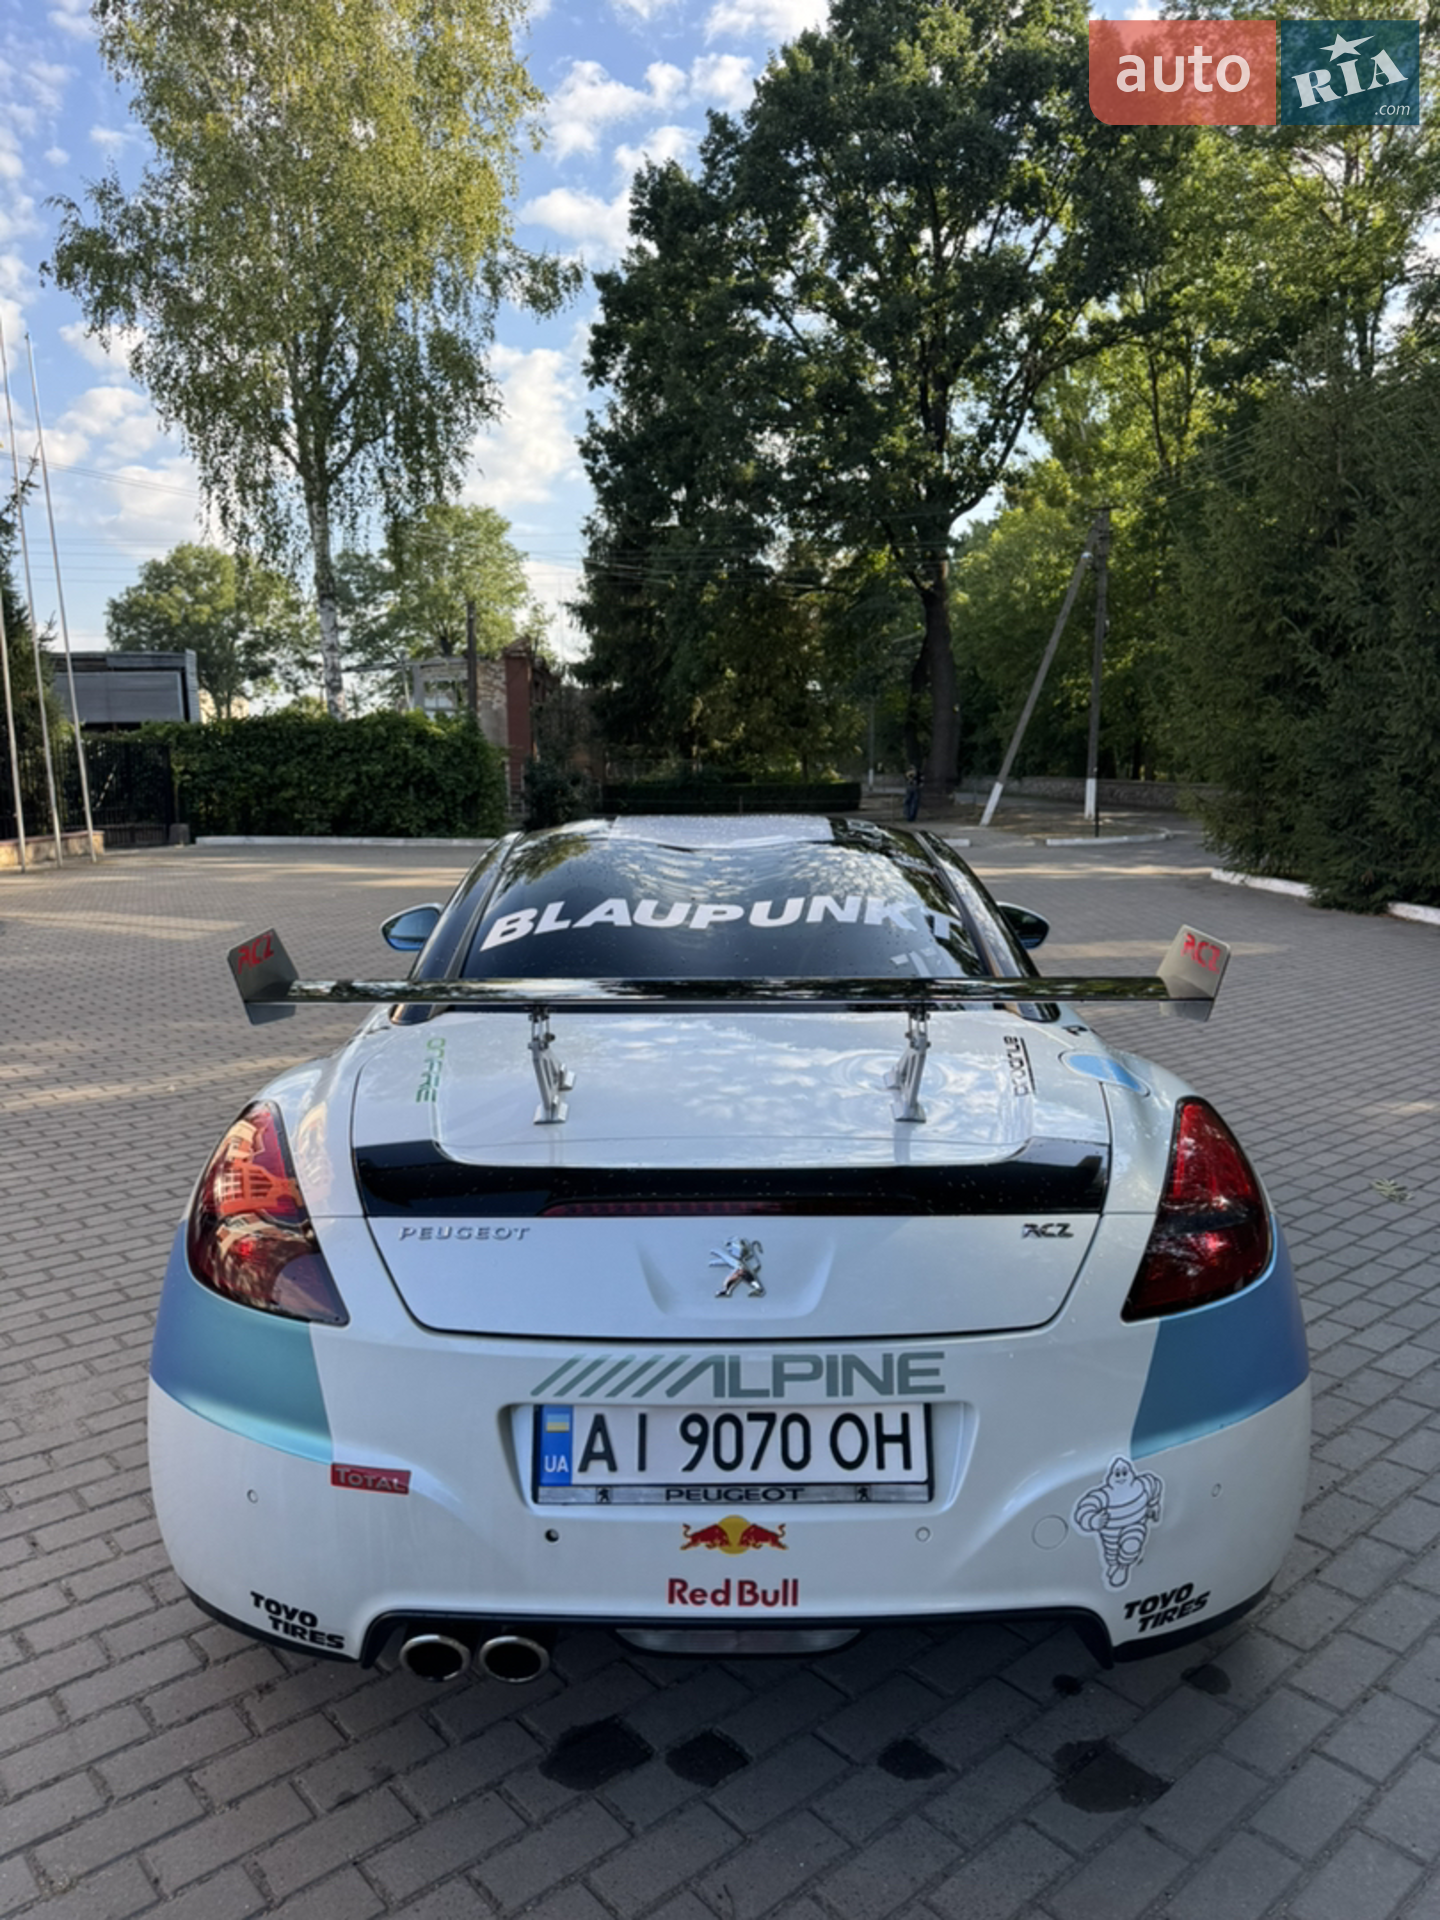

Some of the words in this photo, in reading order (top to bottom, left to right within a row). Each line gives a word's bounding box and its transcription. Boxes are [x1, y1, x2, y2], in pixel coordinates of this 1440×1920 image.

[399, 1226, 531, 1241] PEUGEOT
[1022, 1223, 1074, 1238] RCZ
[679, 1412, 812, 1472] 9070
[830, 1412, 913, 1472] OH
[544, 1455, 569, 1473] UA
[335, 1468, 406, 1491] TOTAL
[665, 1488, 806, 1501] PEUGEOT
[667, 1578, 731, 1607] Red
[738, 1578, 799, 1607] Bull
[1124, 1582, 1194, 1619] TOYO
[250, 1590, 318, 1628] TOYO
[1138, 1591, 1211, 1633] TIRES
[268, 1615, 345, 1649] TIRES
